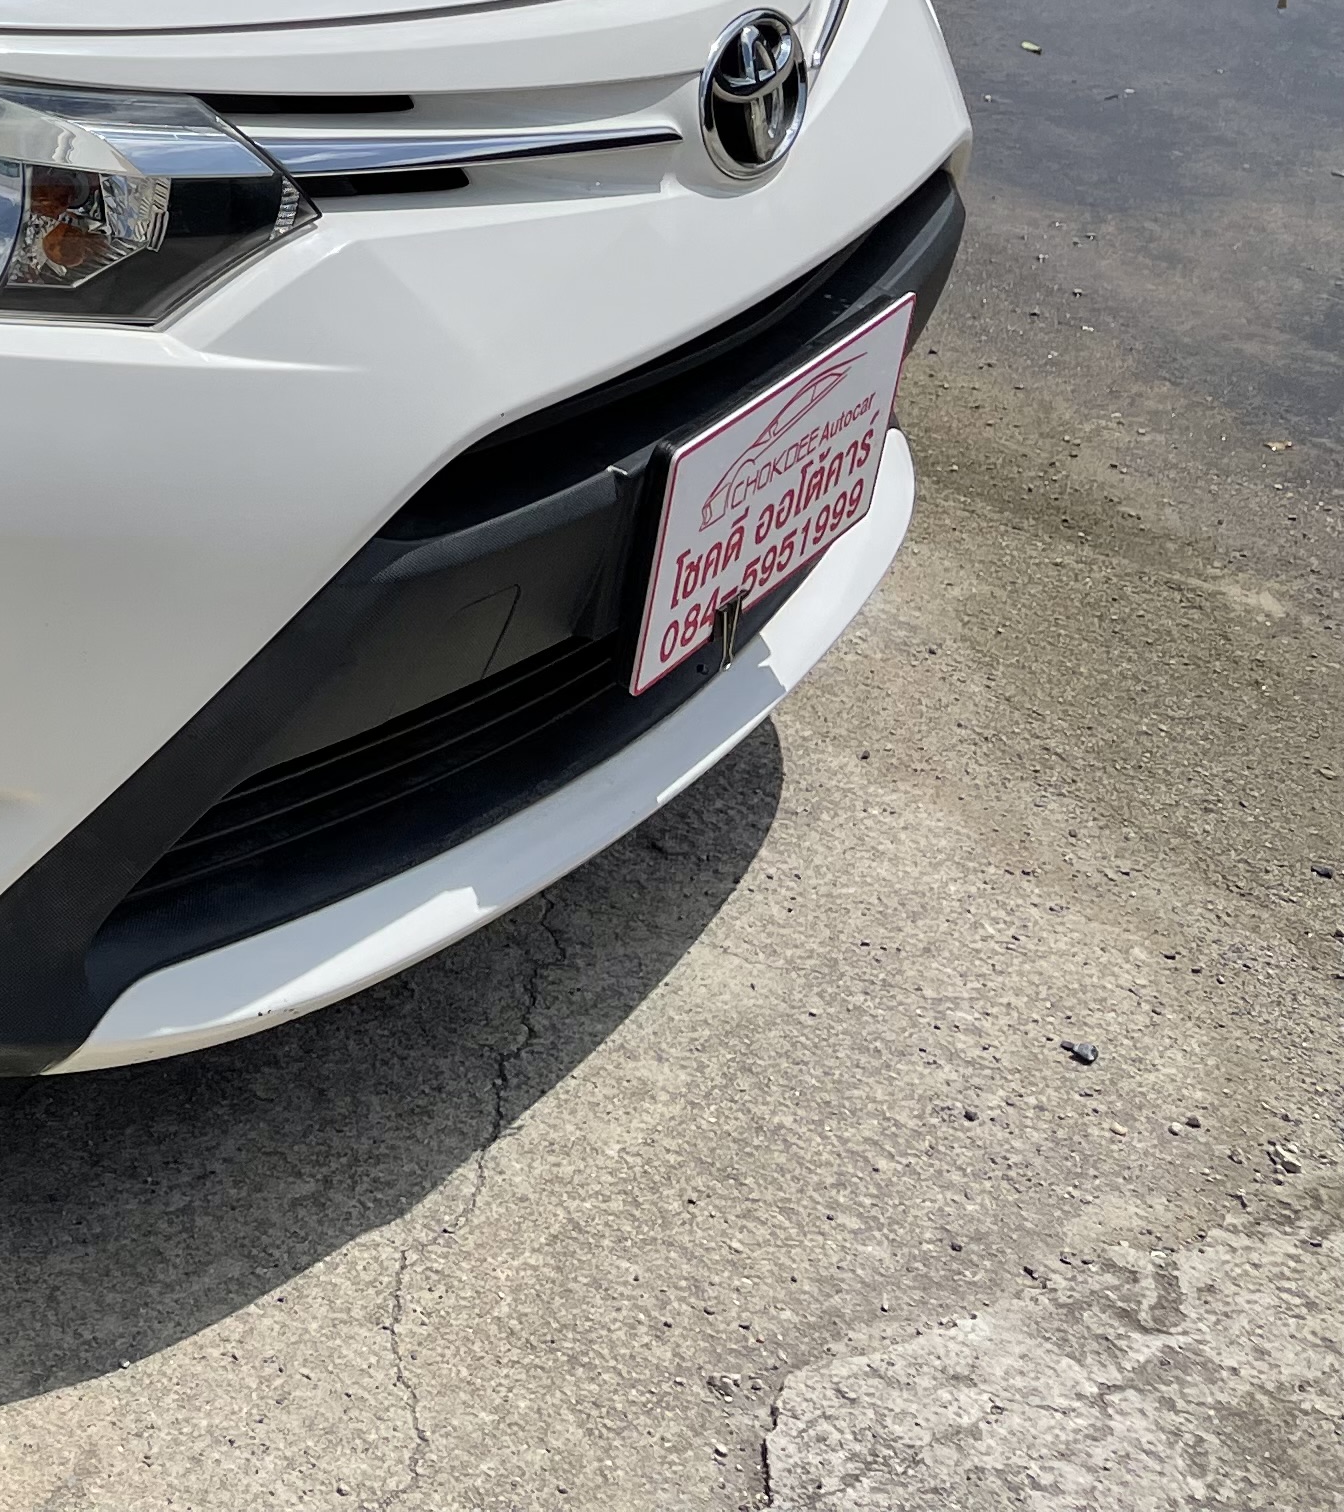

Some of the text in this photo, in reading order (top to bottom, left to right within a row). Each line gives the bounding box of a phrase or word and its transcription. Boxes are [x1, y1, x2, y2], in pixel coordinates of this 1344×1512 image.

[659, 478, 864, 663] 084-5951999
[670, 409, 880, 609] โชคดี ออโต้คาร์
